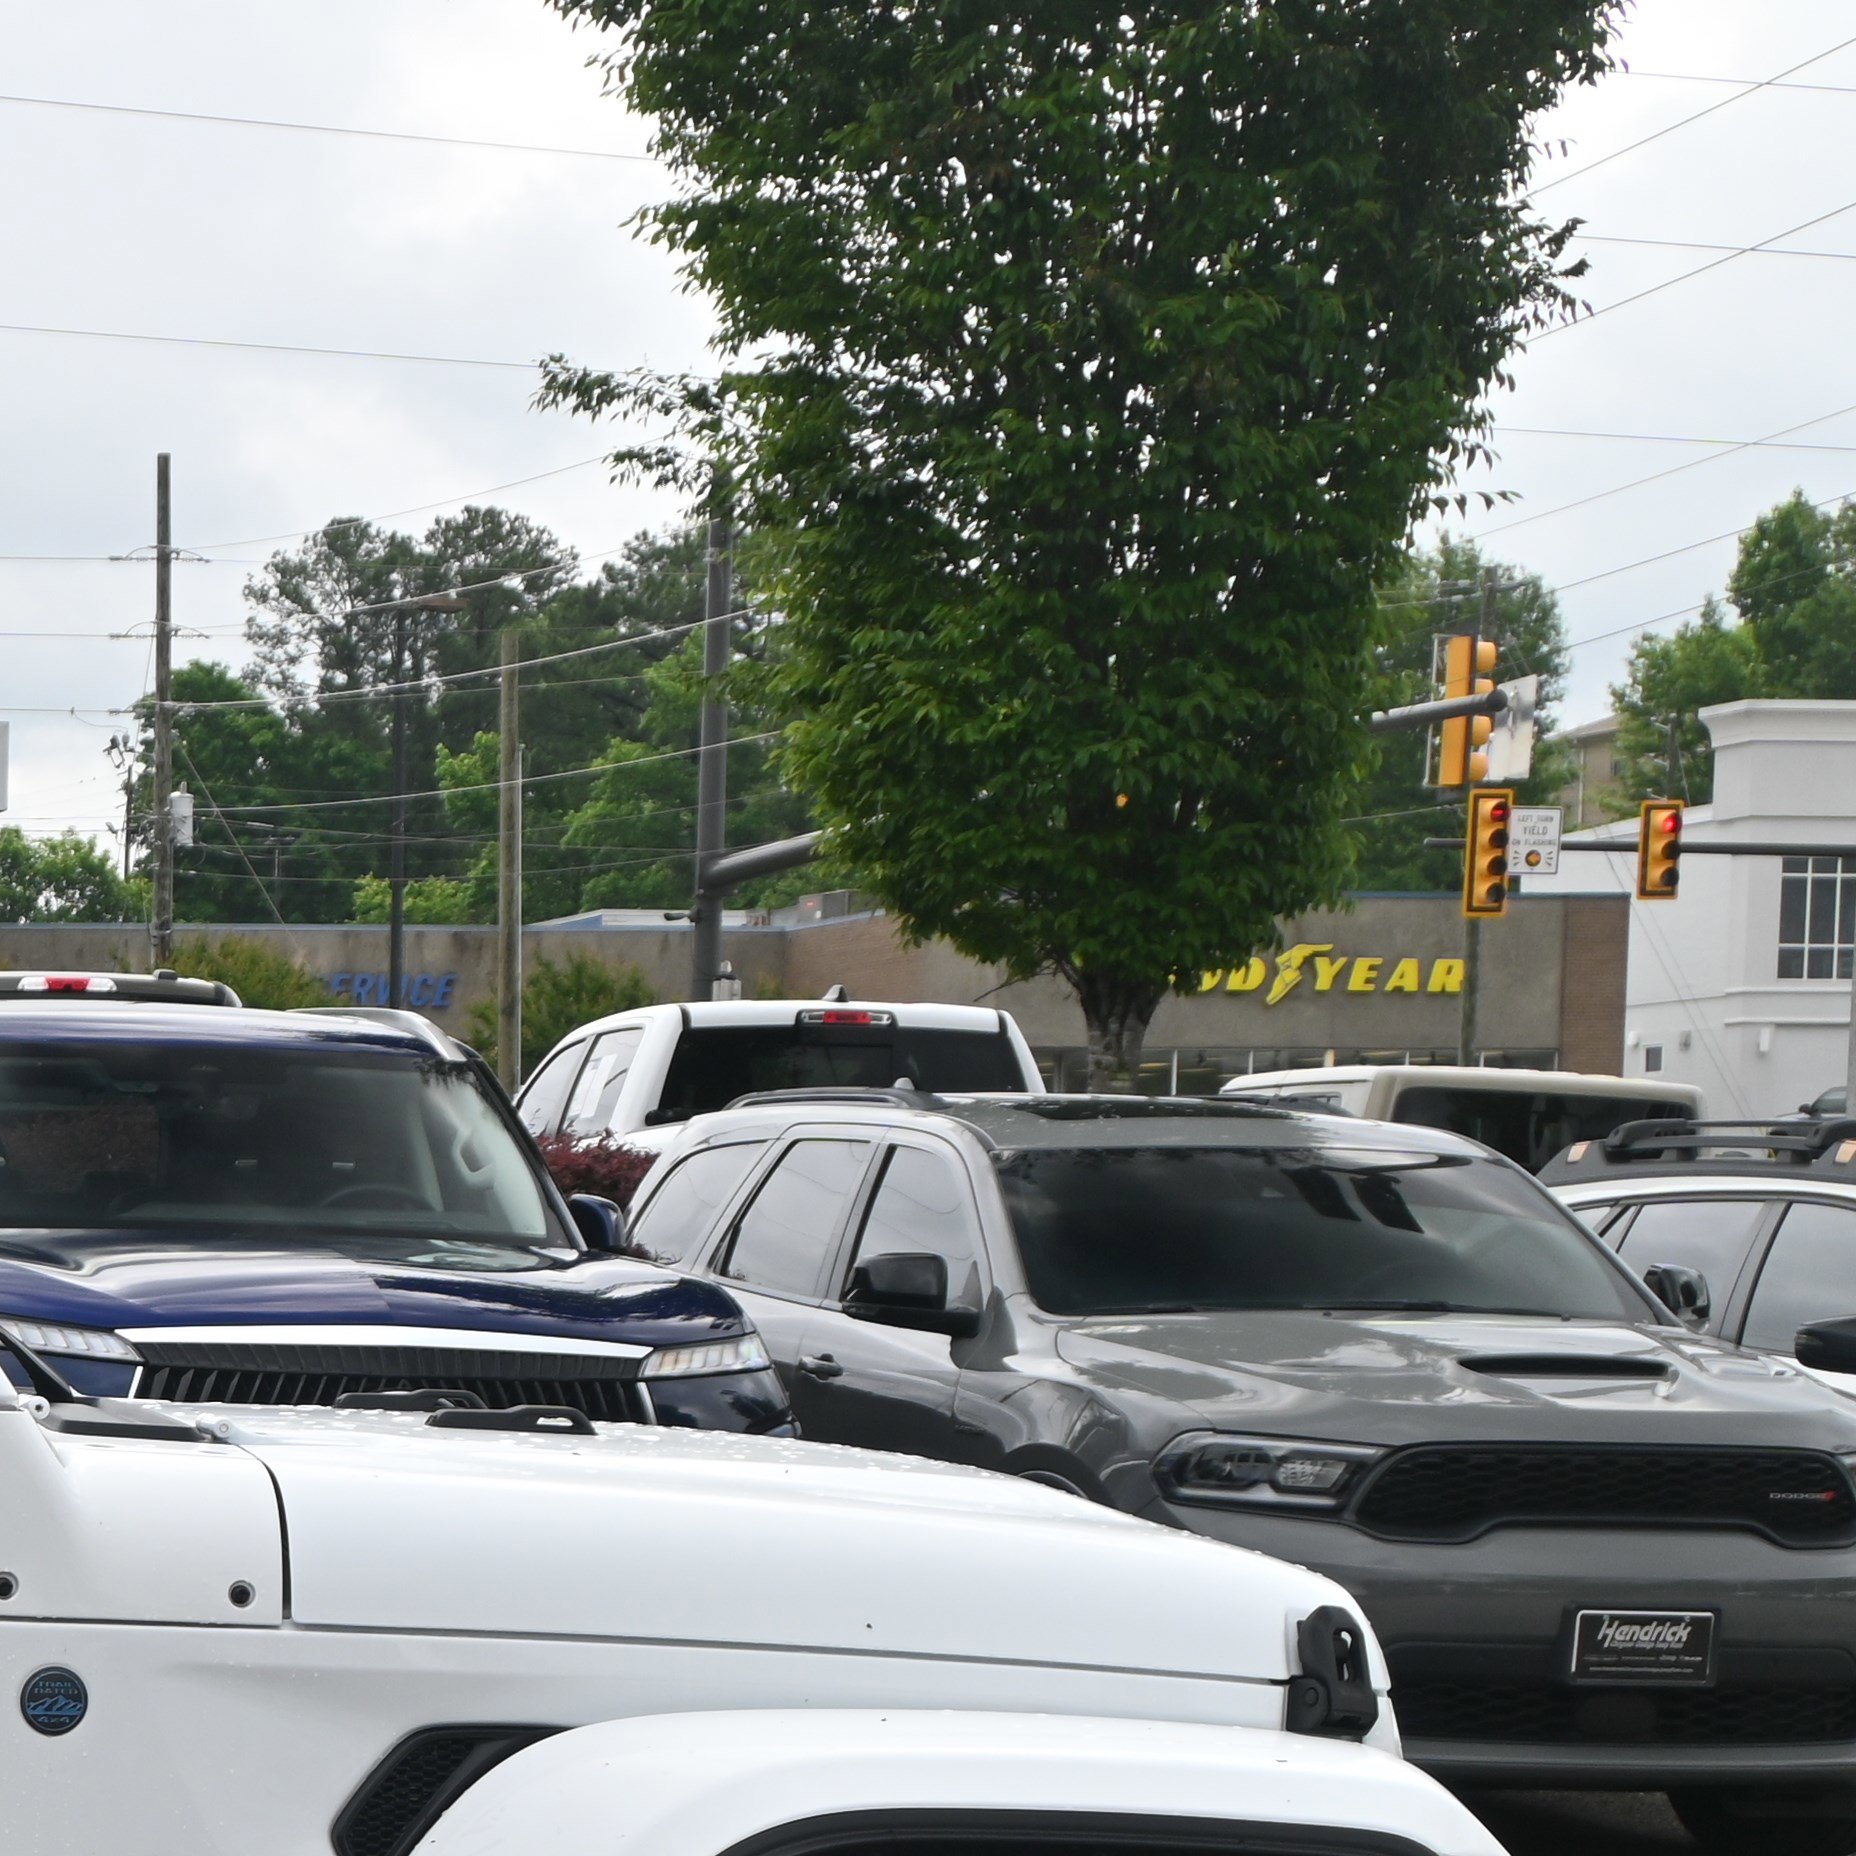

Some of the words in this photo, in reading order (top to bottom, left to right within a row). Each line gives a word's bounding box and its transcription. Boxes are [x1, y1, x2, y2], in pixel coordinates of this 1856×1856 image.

[1518, 814, 1533, 822] LEFT
[1523, 825, 1548, 836] YIELD
[324, 972, 459, 1008] ERVICE
[1769, 1492, 1828, 1500] DODGE
[1597, 1620, 1692, 1648] Hendrick
